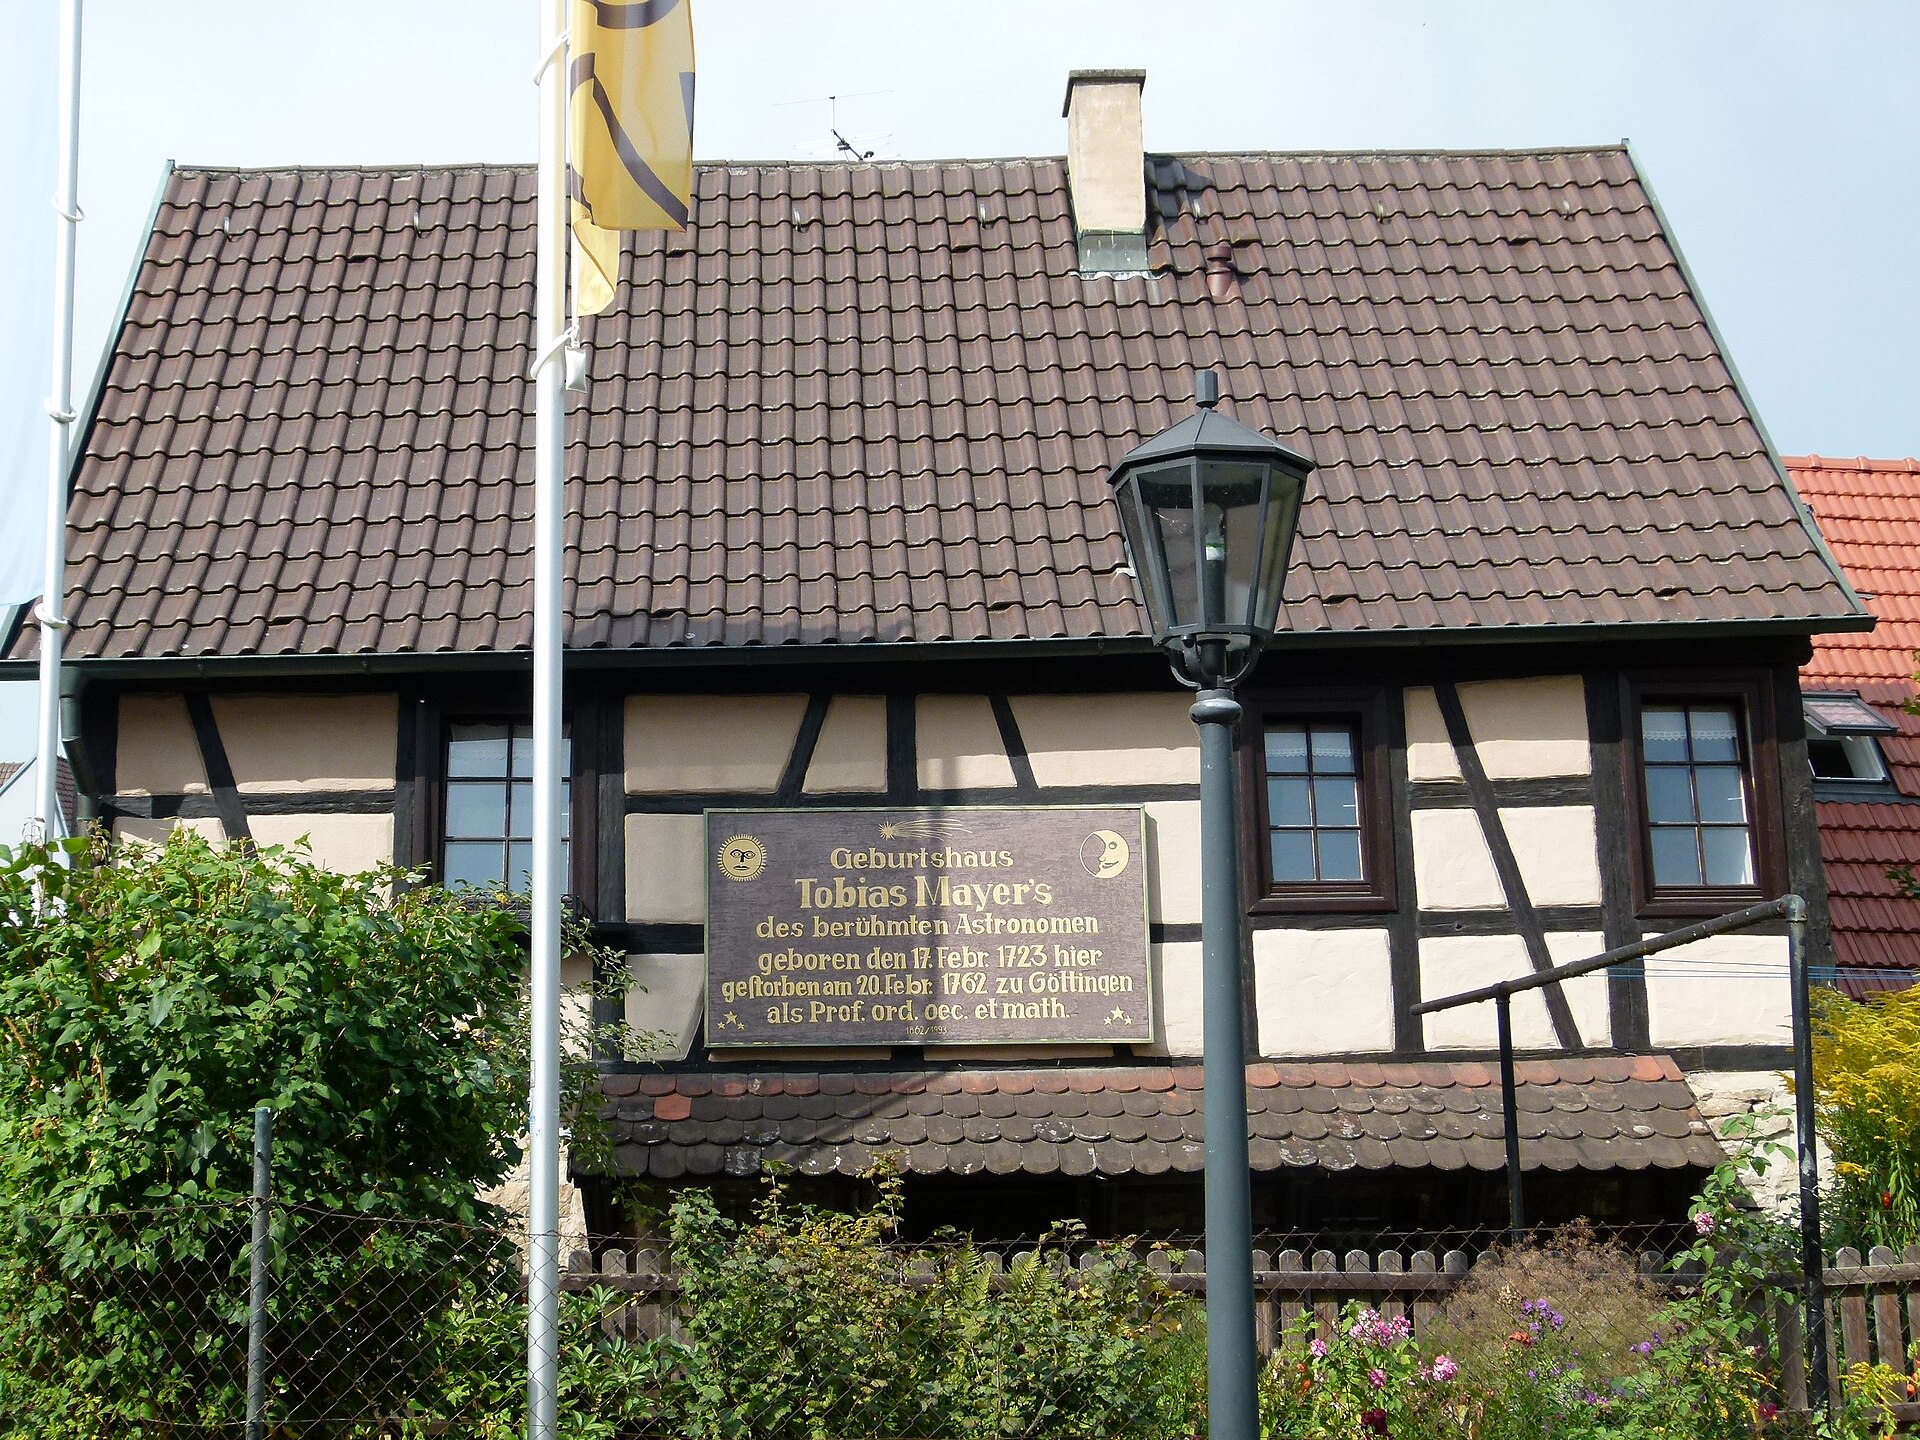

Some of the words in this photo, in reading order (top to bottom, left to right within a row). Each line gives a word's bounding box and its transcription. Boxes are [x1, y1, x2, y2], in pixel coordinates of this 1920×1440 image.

[830, 846, 1014, 870] Geburtshaus
[794, 876, 908, 909] Tobias
[914, 875, 1053, 912] Mayer's
[756, 915, 804, 938] des
[812, 914, 949, 938] berühmten
[955, 912, 1099, 935] Astronomen
[758, 947, 861, 976] geboren
[866, 946, 907, 970] den
[911, 946, 933, 969] 17.
[936, 946, 990, 969] Febr.
[997, 945, 1048, 968] 1723
[1053, 944, 1103, 967] hier
[823, 981, 852, 996] am
[941, 972, 989, 995] 1762
[996, 977, 1024, 994] zu
[1028, 970, 1133, 996] Göttingen
[767, 1002, 804, 1024] als
[809, 1000, 866, 1024] Prof.
[871, 1000, 919, 1022] ord.
[925, 1002, 968, 1021] oec.
[974, 998, 998, 1019] et
[1003, 997, 1070, 1019] math.
